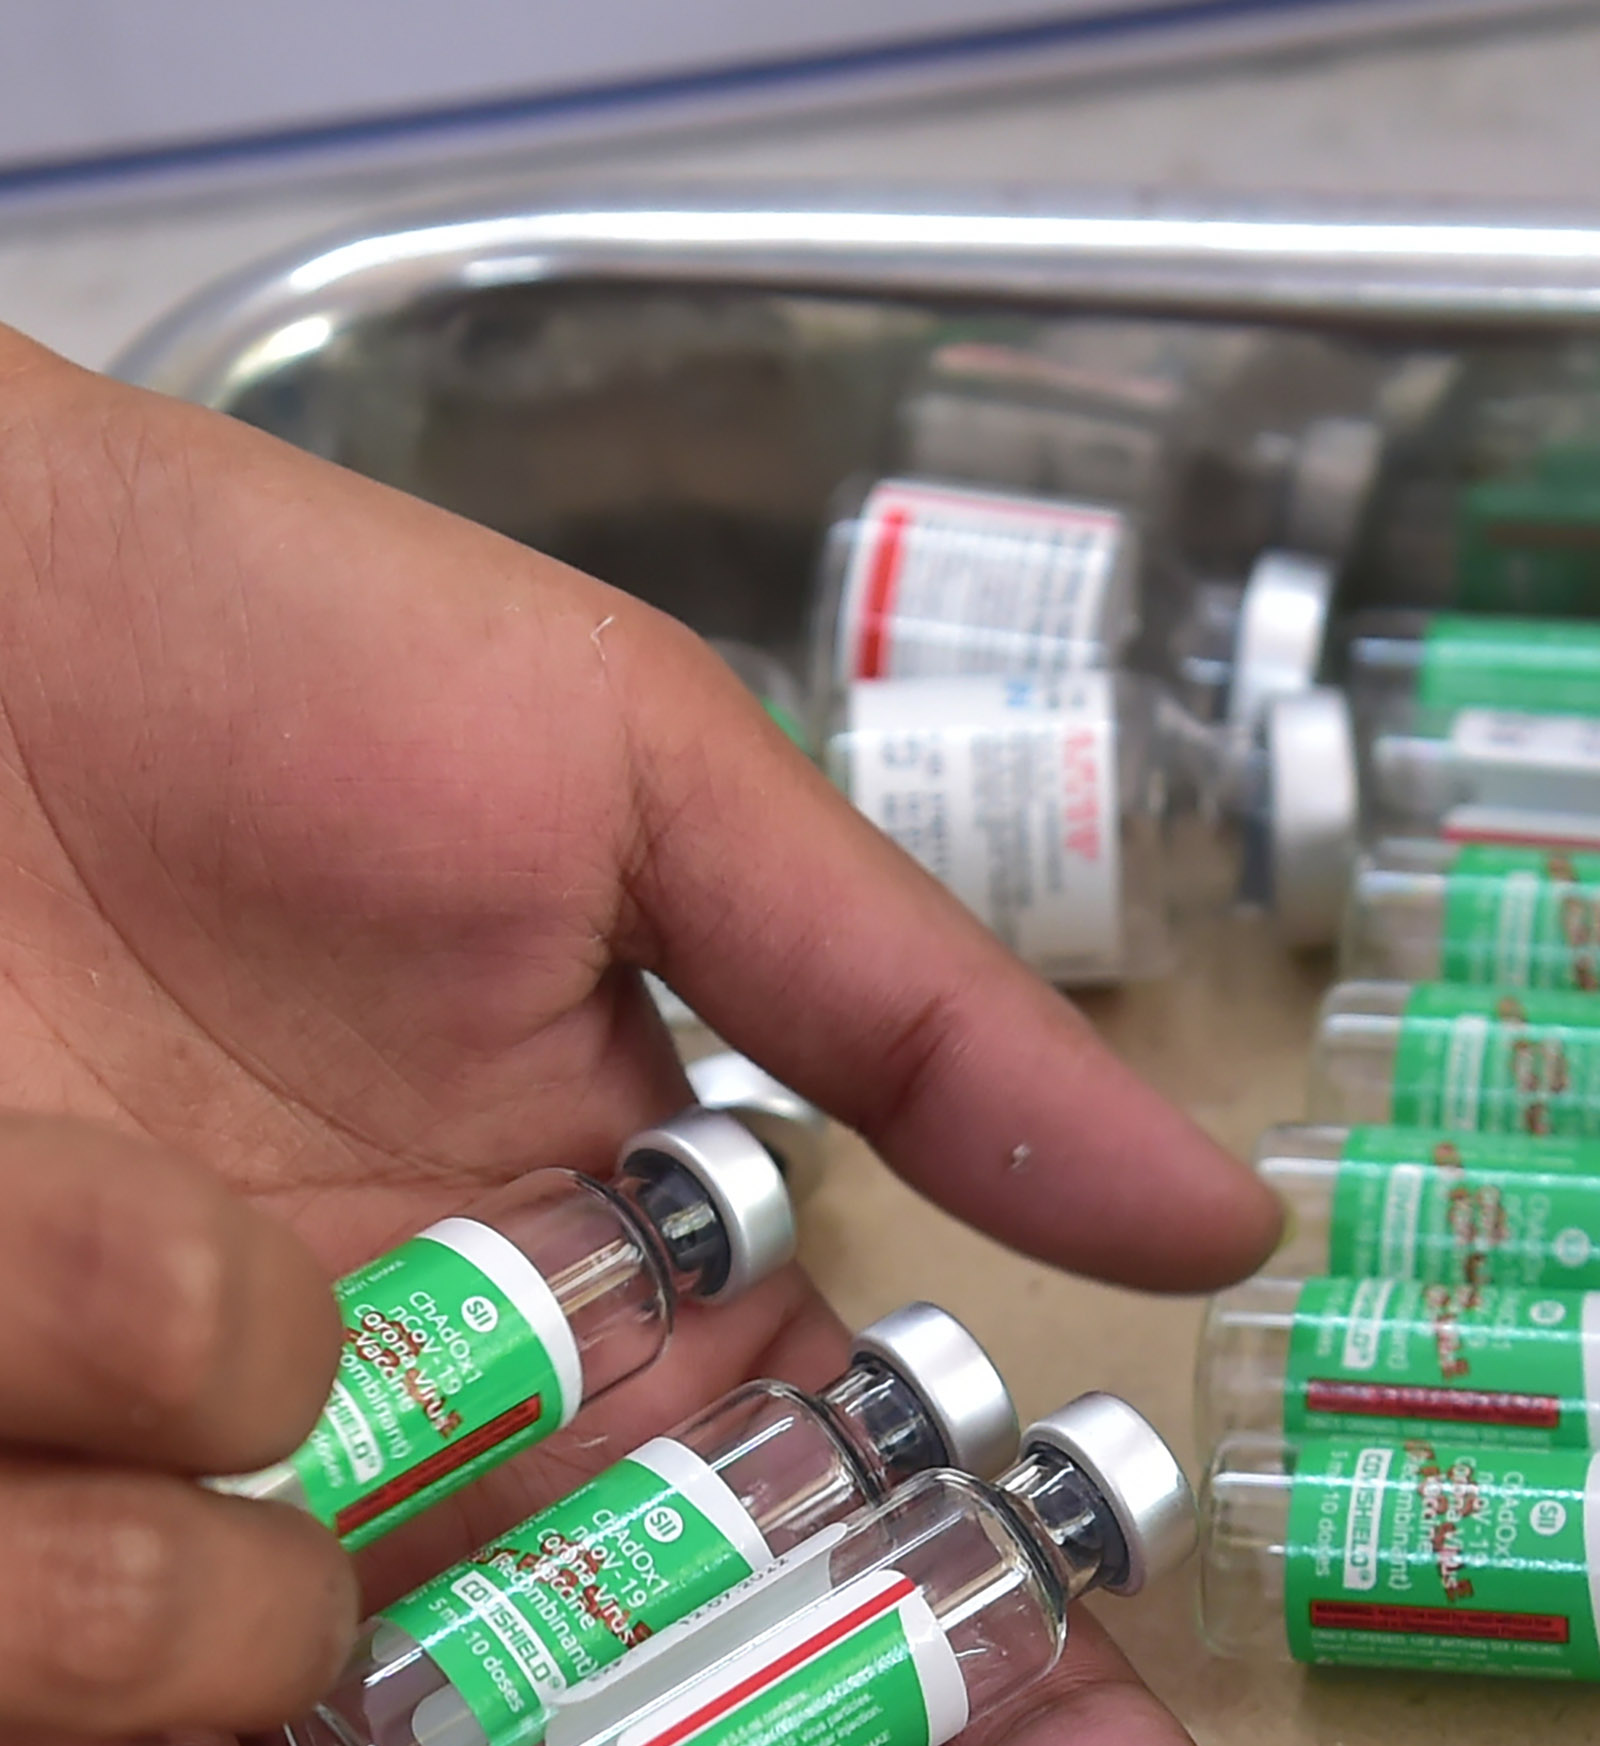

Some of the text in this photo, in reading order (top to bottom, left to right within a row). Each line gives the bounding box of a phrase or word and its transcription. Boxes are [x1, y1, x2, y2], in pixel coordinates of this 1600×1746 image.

[409, 1291, 483, 1384] ChAdOx1
[466, 1299, 495, 1328] SII
[649, 1510, 679, 1538] SII
[1492, 1470, 1524, 1566] CAdOx
[483, 1653, 525, 1713] doses
